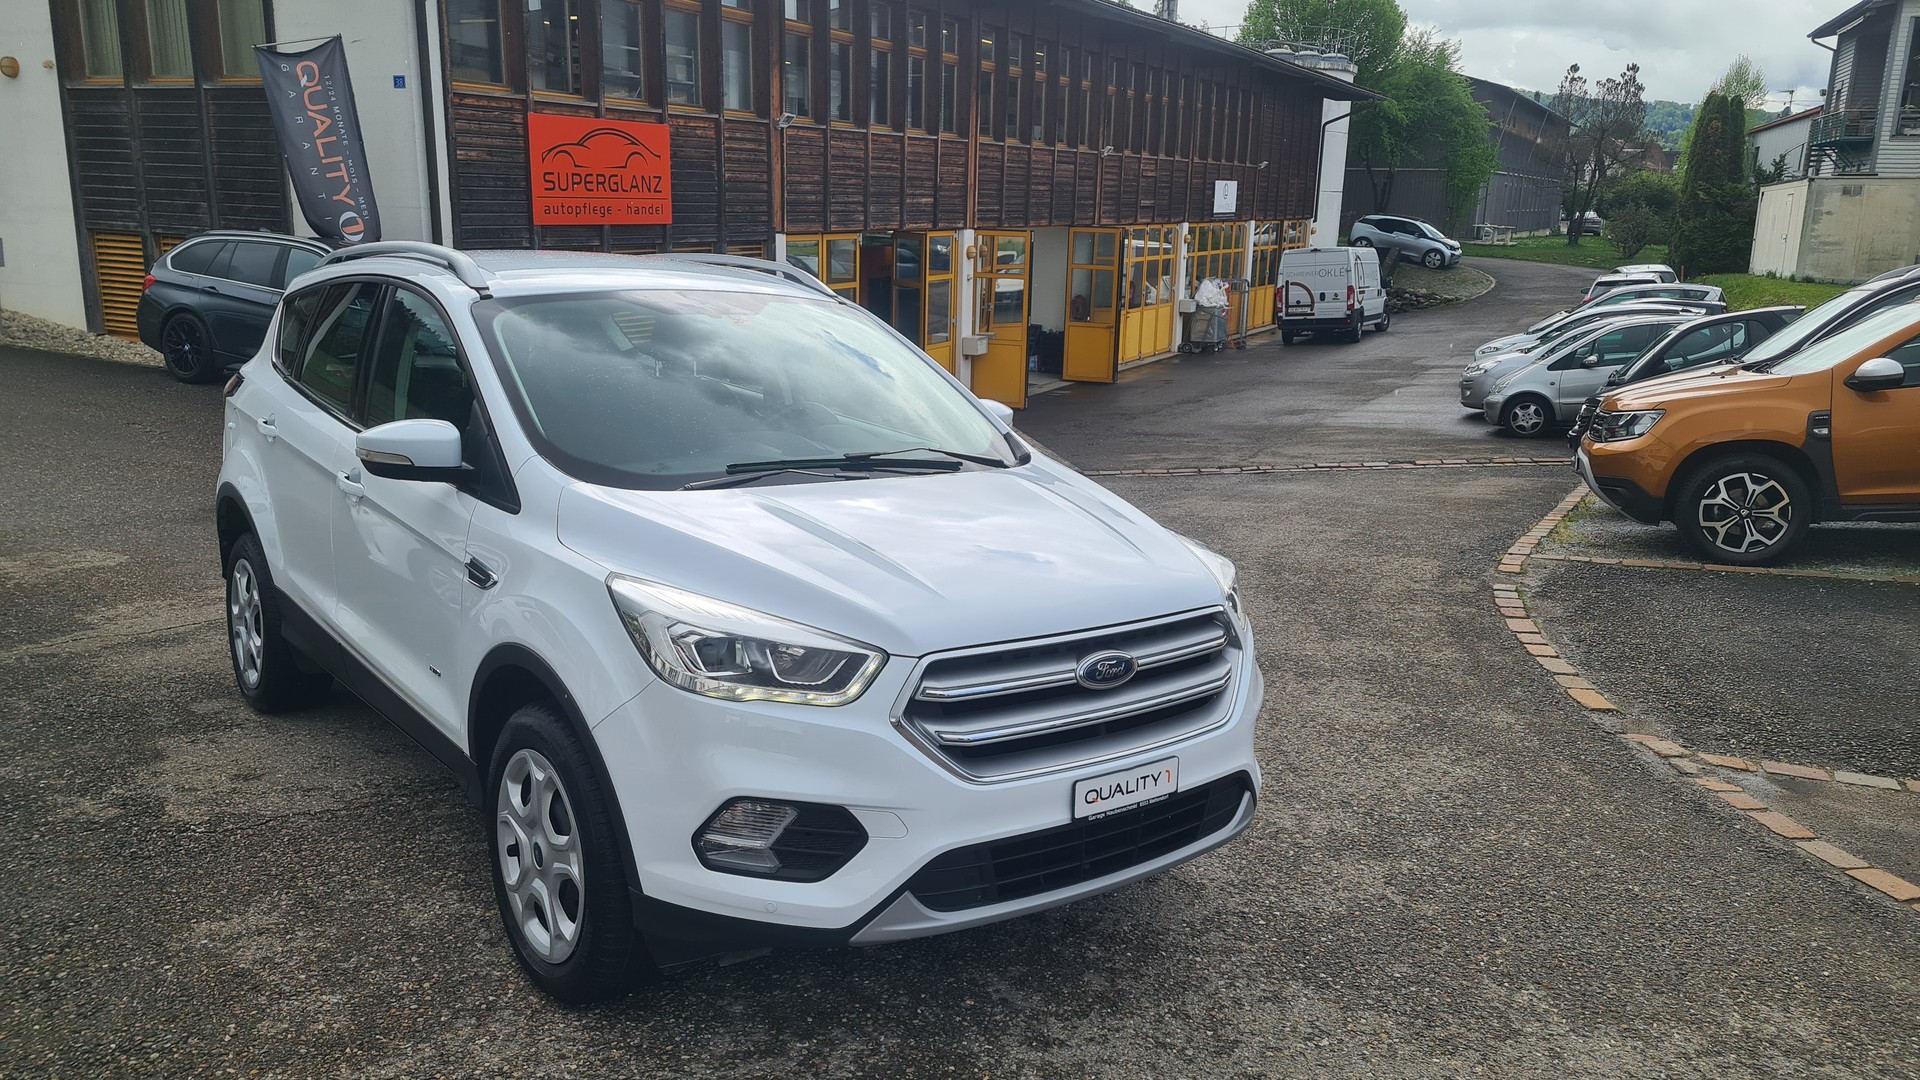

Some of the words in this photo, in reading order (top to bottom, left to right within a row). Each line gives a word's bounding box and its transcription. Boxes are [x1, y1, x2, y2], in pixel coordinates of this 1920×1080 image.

[296, 60, 356, 206] QUALITY
[323, 75, 336, 102] 12/24
[332, 105, 348, 146] MONATE
[347, 159, 358, 184] MOIS
[358, 196, 370, 220] MESI
[543, 171, 663, 193] SUPERGLANZ
[544, 202, 613, 218] autopflege
[626, 203, 664, 216] handel
[1095, 660, 1125, 680] Ford
[1084, 771, 1162, 805] QUALITY
[1165, 769, 1171, 784] 1
[1088, 812, 1106, 821] Garage
